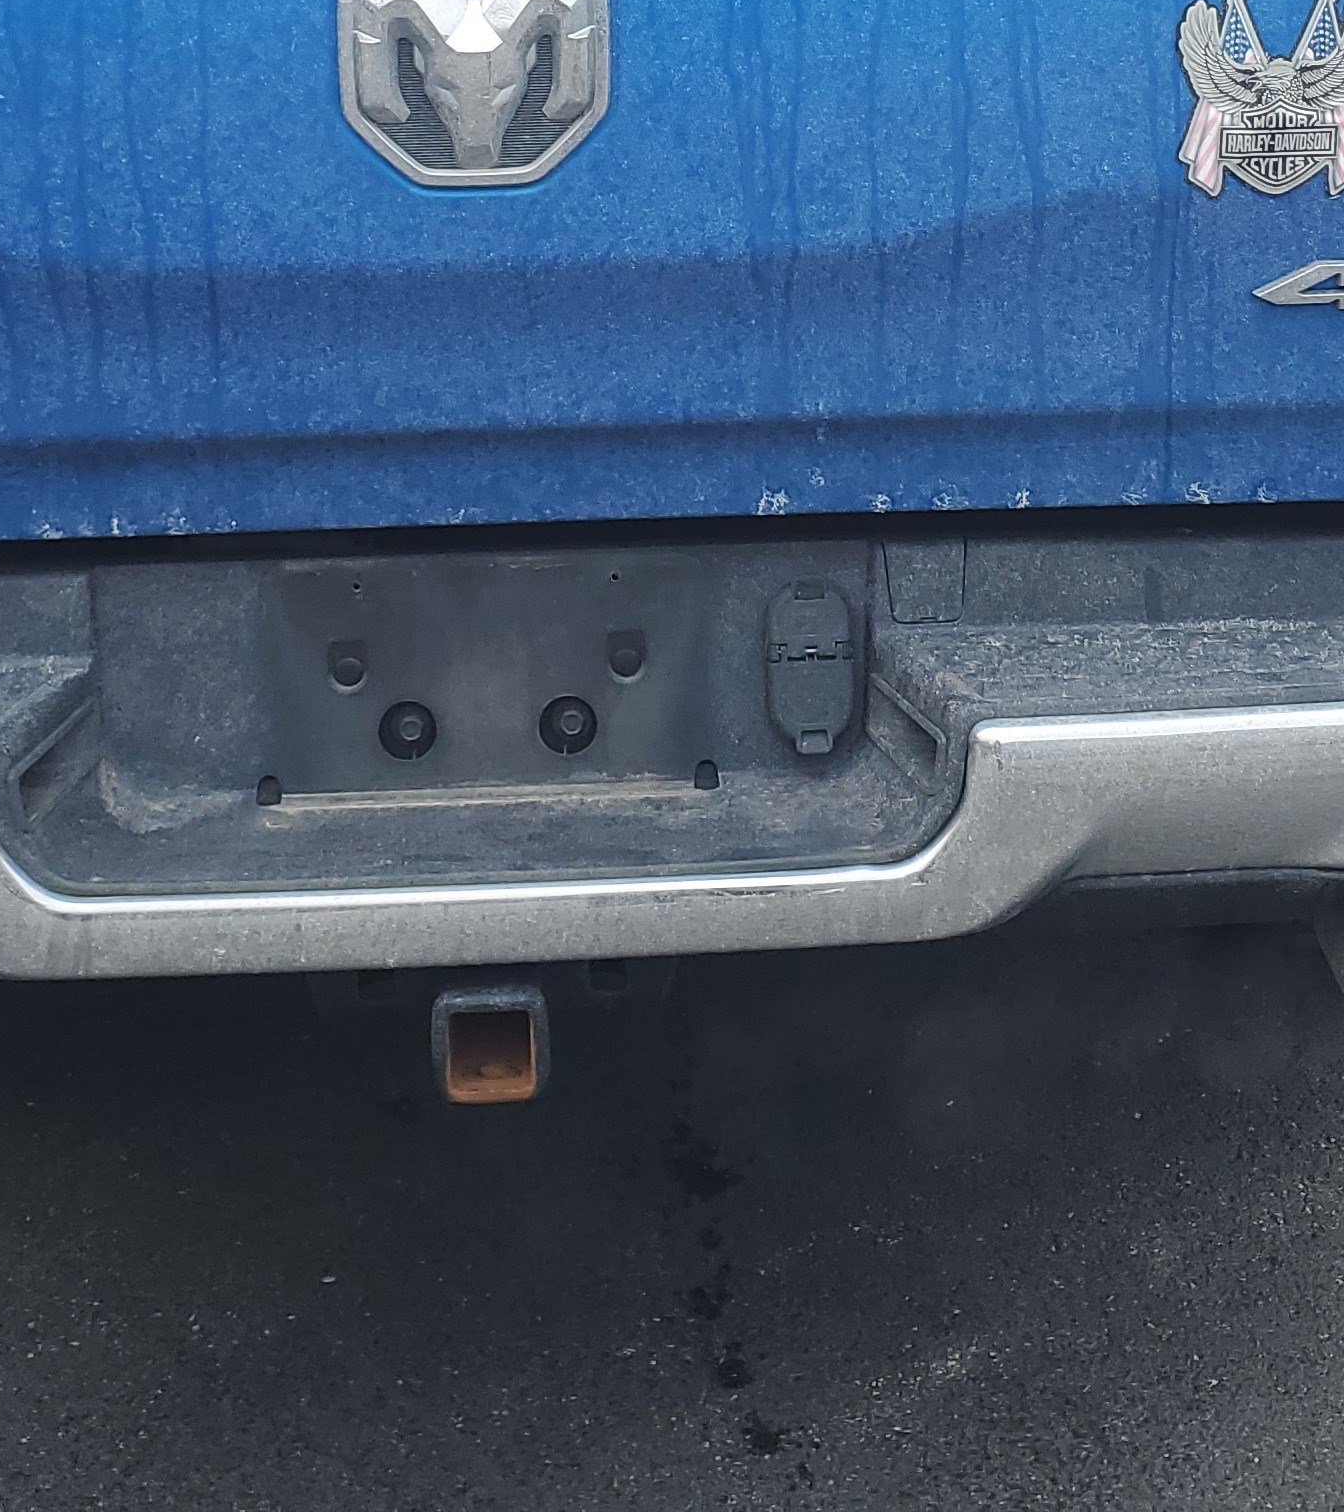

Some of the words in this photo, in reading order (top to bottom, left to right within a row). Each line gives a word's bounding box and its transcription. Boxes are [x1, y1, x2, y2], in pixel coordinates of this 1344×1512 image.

[1252, 110, 1309, 129] MOTOR
[1227, 132, 1331, 153] HARLEY-DAVIDSON
[1249, 156, 1306, 180] CYCLES
